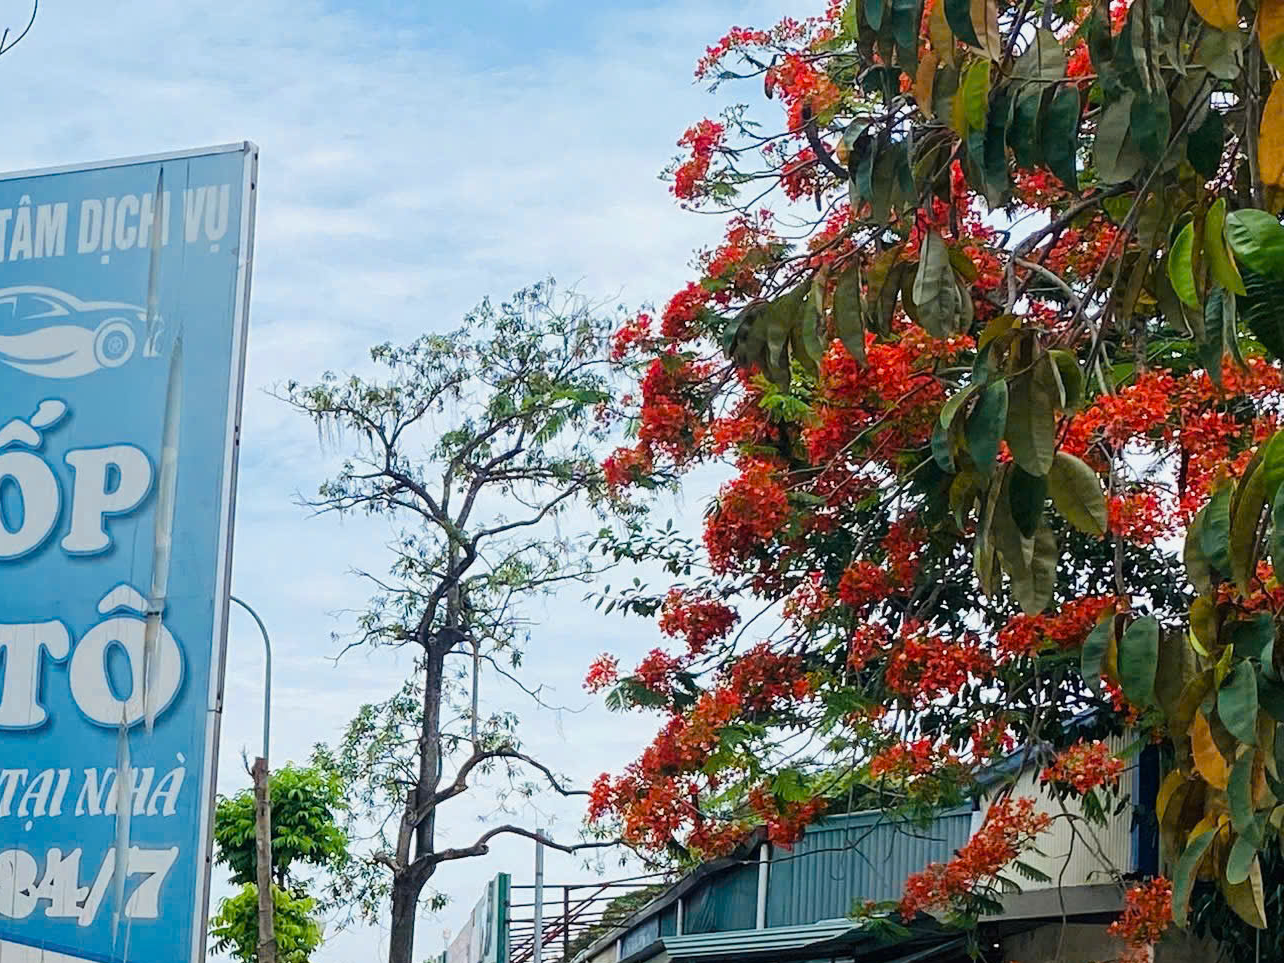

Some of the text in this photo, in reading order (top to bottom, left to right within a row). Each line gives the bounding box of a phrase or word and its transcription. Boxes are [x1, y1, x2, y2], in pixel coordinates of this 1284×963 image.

[77, 190, 169, 265] DỊCH
[184, 183, 231, 252] VỤ
[75, 751, 187, 818] NHÀ
